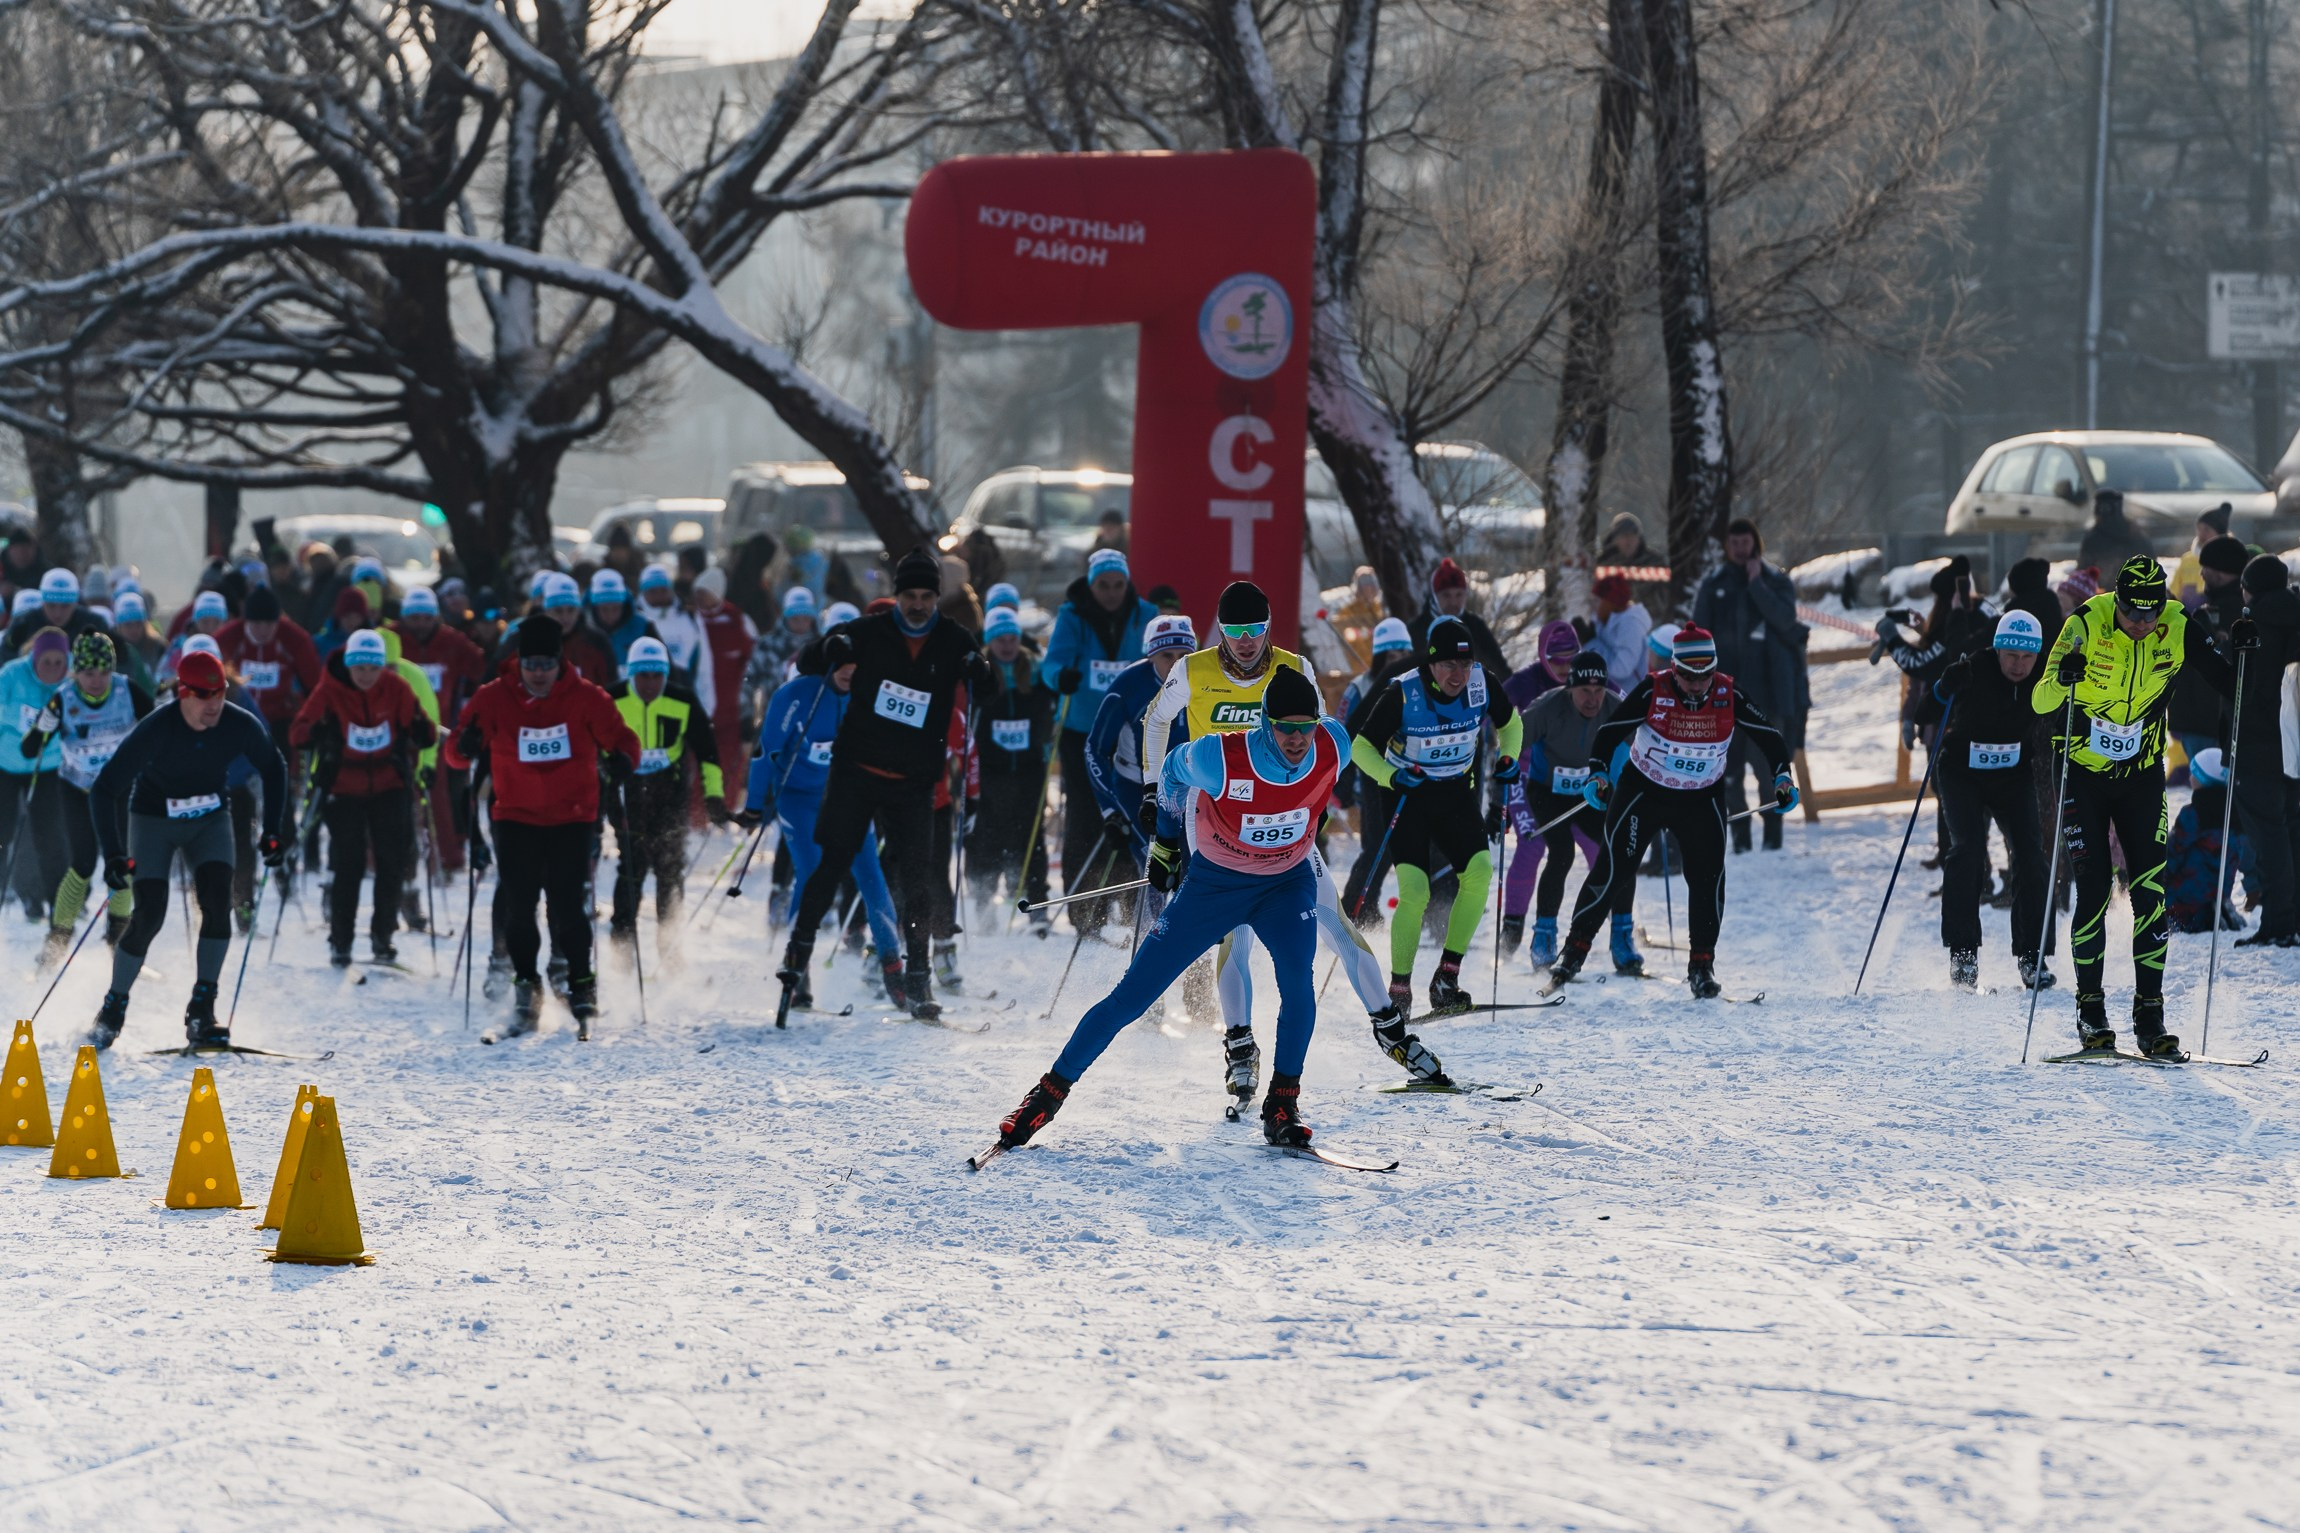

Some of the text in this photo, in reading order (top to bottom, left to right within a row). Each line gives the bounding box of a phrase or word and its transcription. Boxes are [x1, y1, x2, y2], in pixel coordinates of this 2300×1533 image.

[978, 205, 1147, 244] КУРОРТНЫЙ
[1014, 236, 1108, 267] РАЙОН
[886, 697, 916, 717] 919
[1450, 720, 1473, 729] CUP
[1670, 718, 1717, 730] ЛЫЖНЫЙ
[1668, 729, 1717, 738] МАРАФОН
[528, 740, 562, 755] 869
[2100, 734, 2135, 753] 890
[1429, 746, 1460, 760] 841
[1979, 753, 2011, 764] 935
[1674, 759, 1706, 773] 858
[1251, 827, 1294, 842] 895
[1213, 832, 1250, 858] ROLLER
